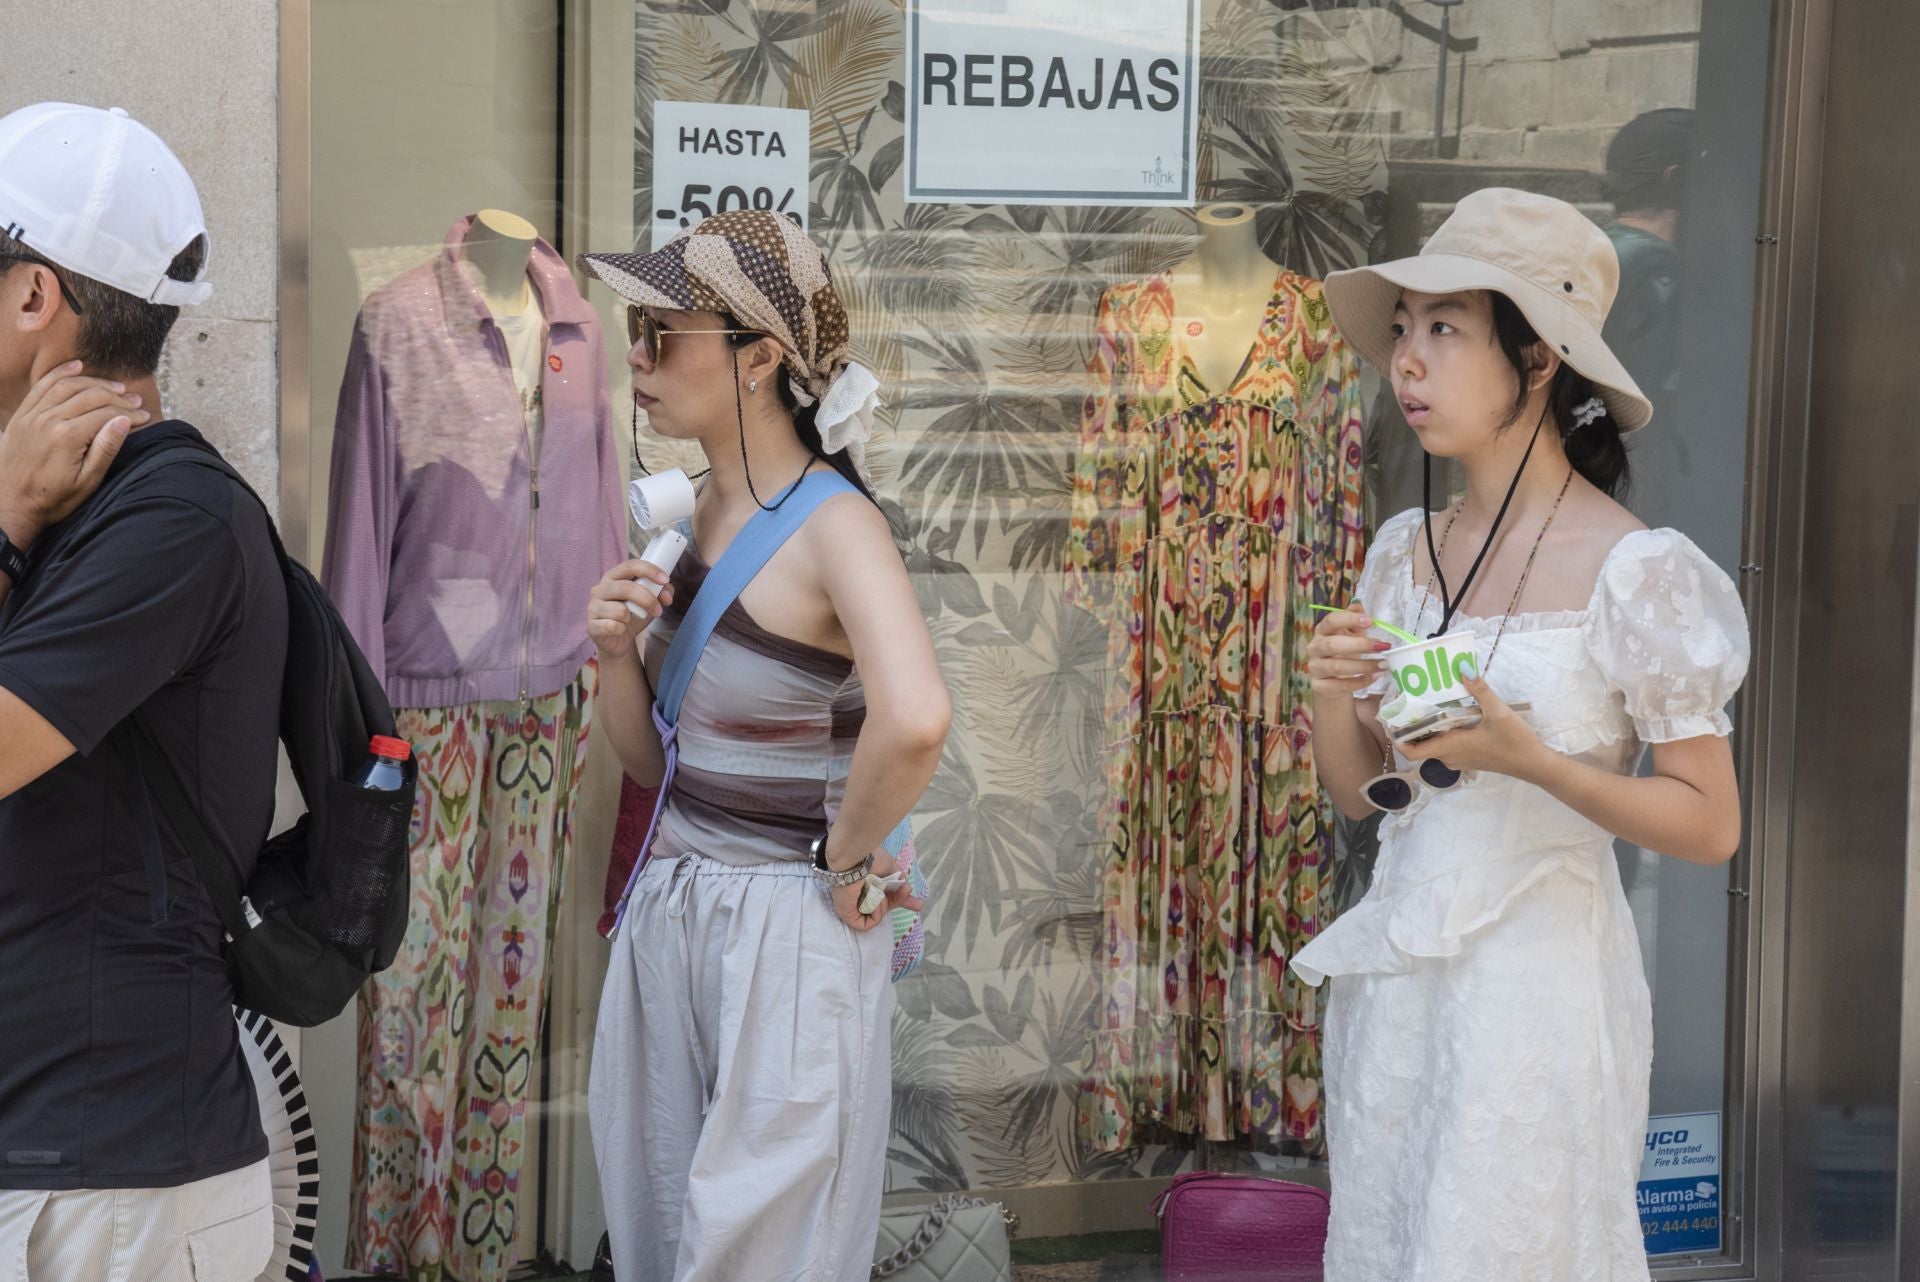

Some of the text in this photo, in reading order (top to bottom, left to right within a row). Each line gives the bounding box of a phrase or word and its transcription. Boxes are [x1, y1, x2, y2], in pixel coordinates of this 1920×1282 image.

[923, 52, 1180, 111] REBAJAS
[679, 126, 786, 158] HASTA
[1645, 1130, 1689, 1151] yco
[1657, 1144, 1702, 1156] Integrated
[1655, 1153, 1716, 1167] Fire & Security
[1651, 1204, 1678, 1214] aviso
[1687, 1199, 1717, 1211] policía
[1642, 1216, 1717, 1235] 02 444 440
